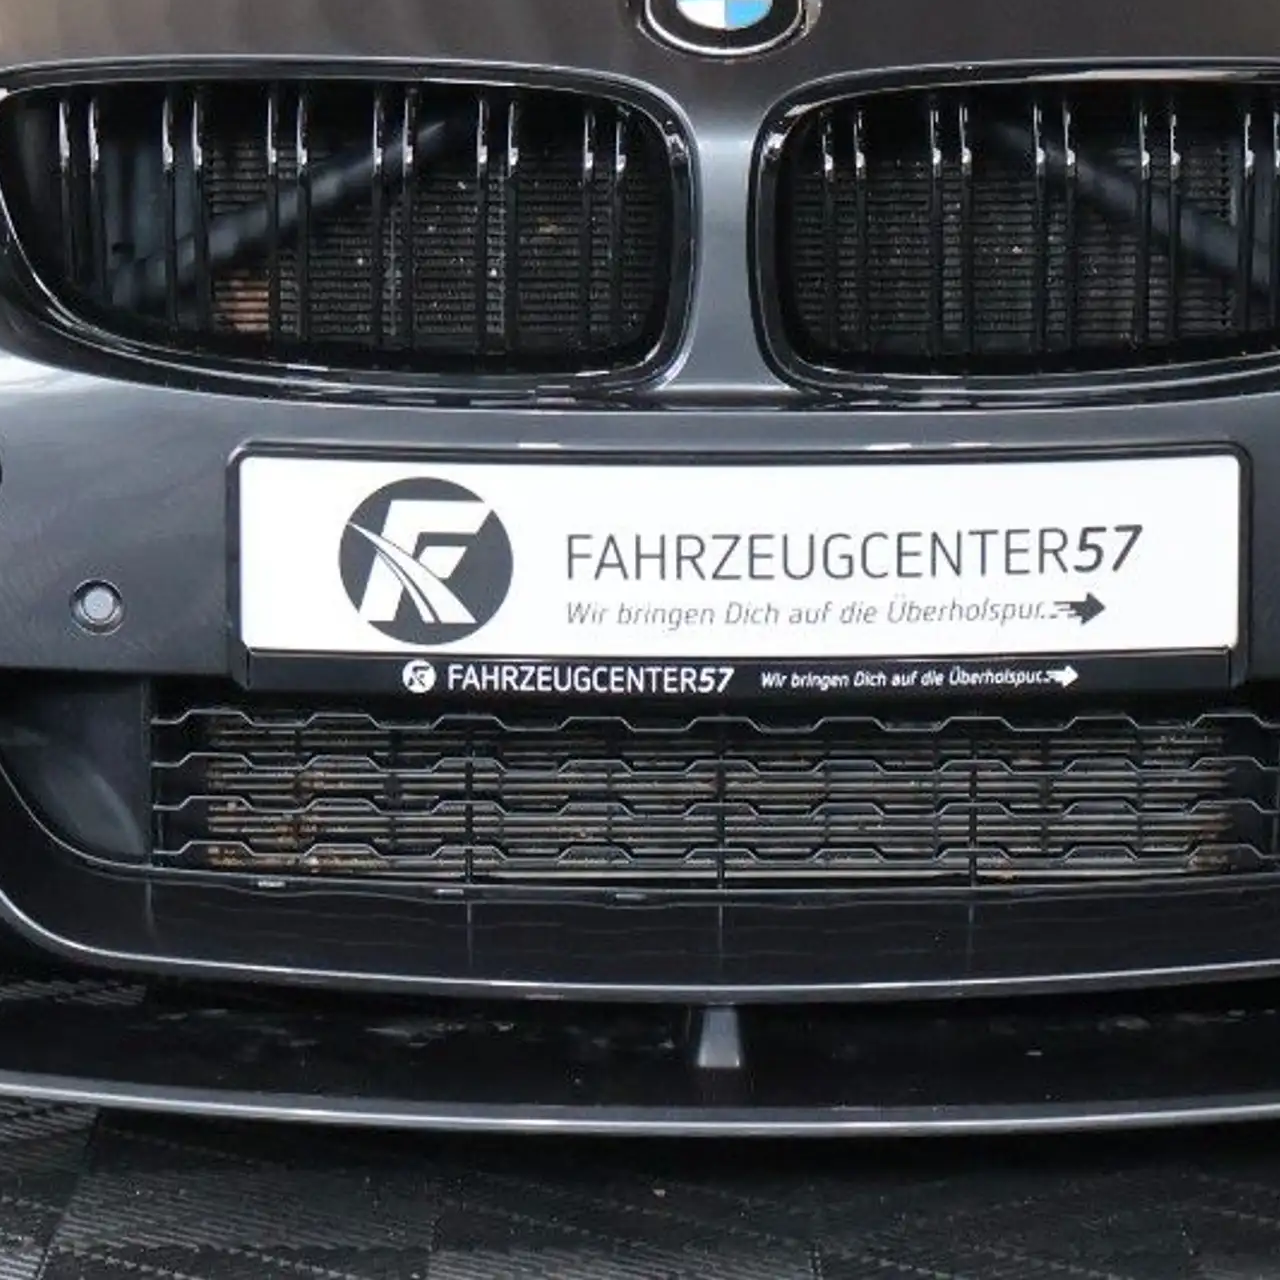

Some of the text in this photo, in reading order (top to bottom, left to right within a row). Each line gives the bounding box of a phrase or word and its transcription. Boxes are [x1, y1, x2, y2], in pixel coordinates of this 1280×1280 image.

[567, 524, 1144, 580] FAHRZEUGCENTER57
[567, 602, 607, 625] Wir
[617, 601, 715, 631] bringen
[725, 601, 780, 625] Dich
[788, 601, 833, 625] auf
[839, 601, 878, 625] die
[447, 664, 735, 693] FAHRZEUGCENTER57
[761, 671, 788, 688] Wir
[790, 671, 850, 691] bringen
[853, 671, 887, 687] Dich
[890, 670, 919, 687] auf
[920, 670, 945, 687] die
